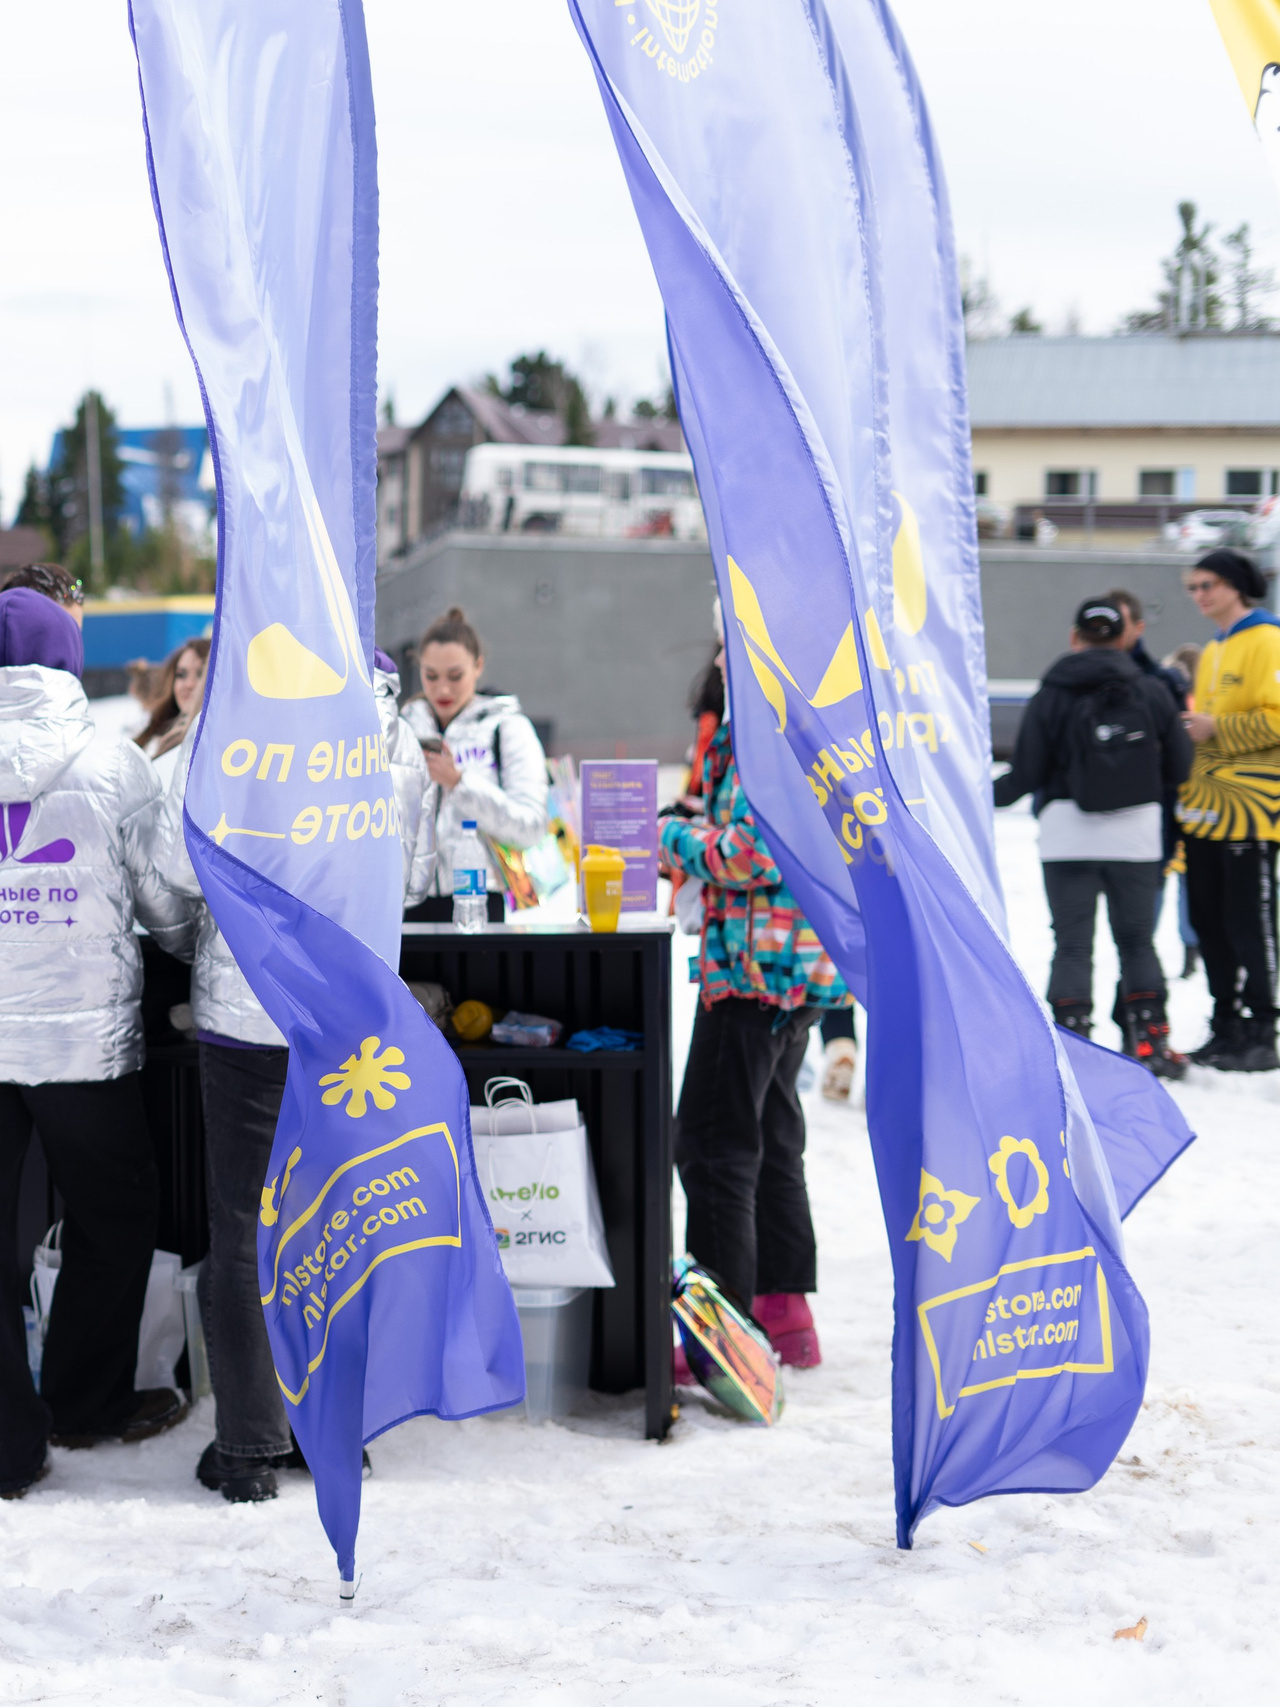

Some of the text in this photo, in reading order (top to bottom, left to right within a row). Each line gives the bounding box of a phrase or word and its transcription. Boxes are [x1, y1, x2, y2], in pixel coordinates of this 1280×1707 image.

[48, 887, 79, 902] по
[281, 1166, 421, 1307] nlstore.com
[514, 1229, 567, 1245] 2ГИС
